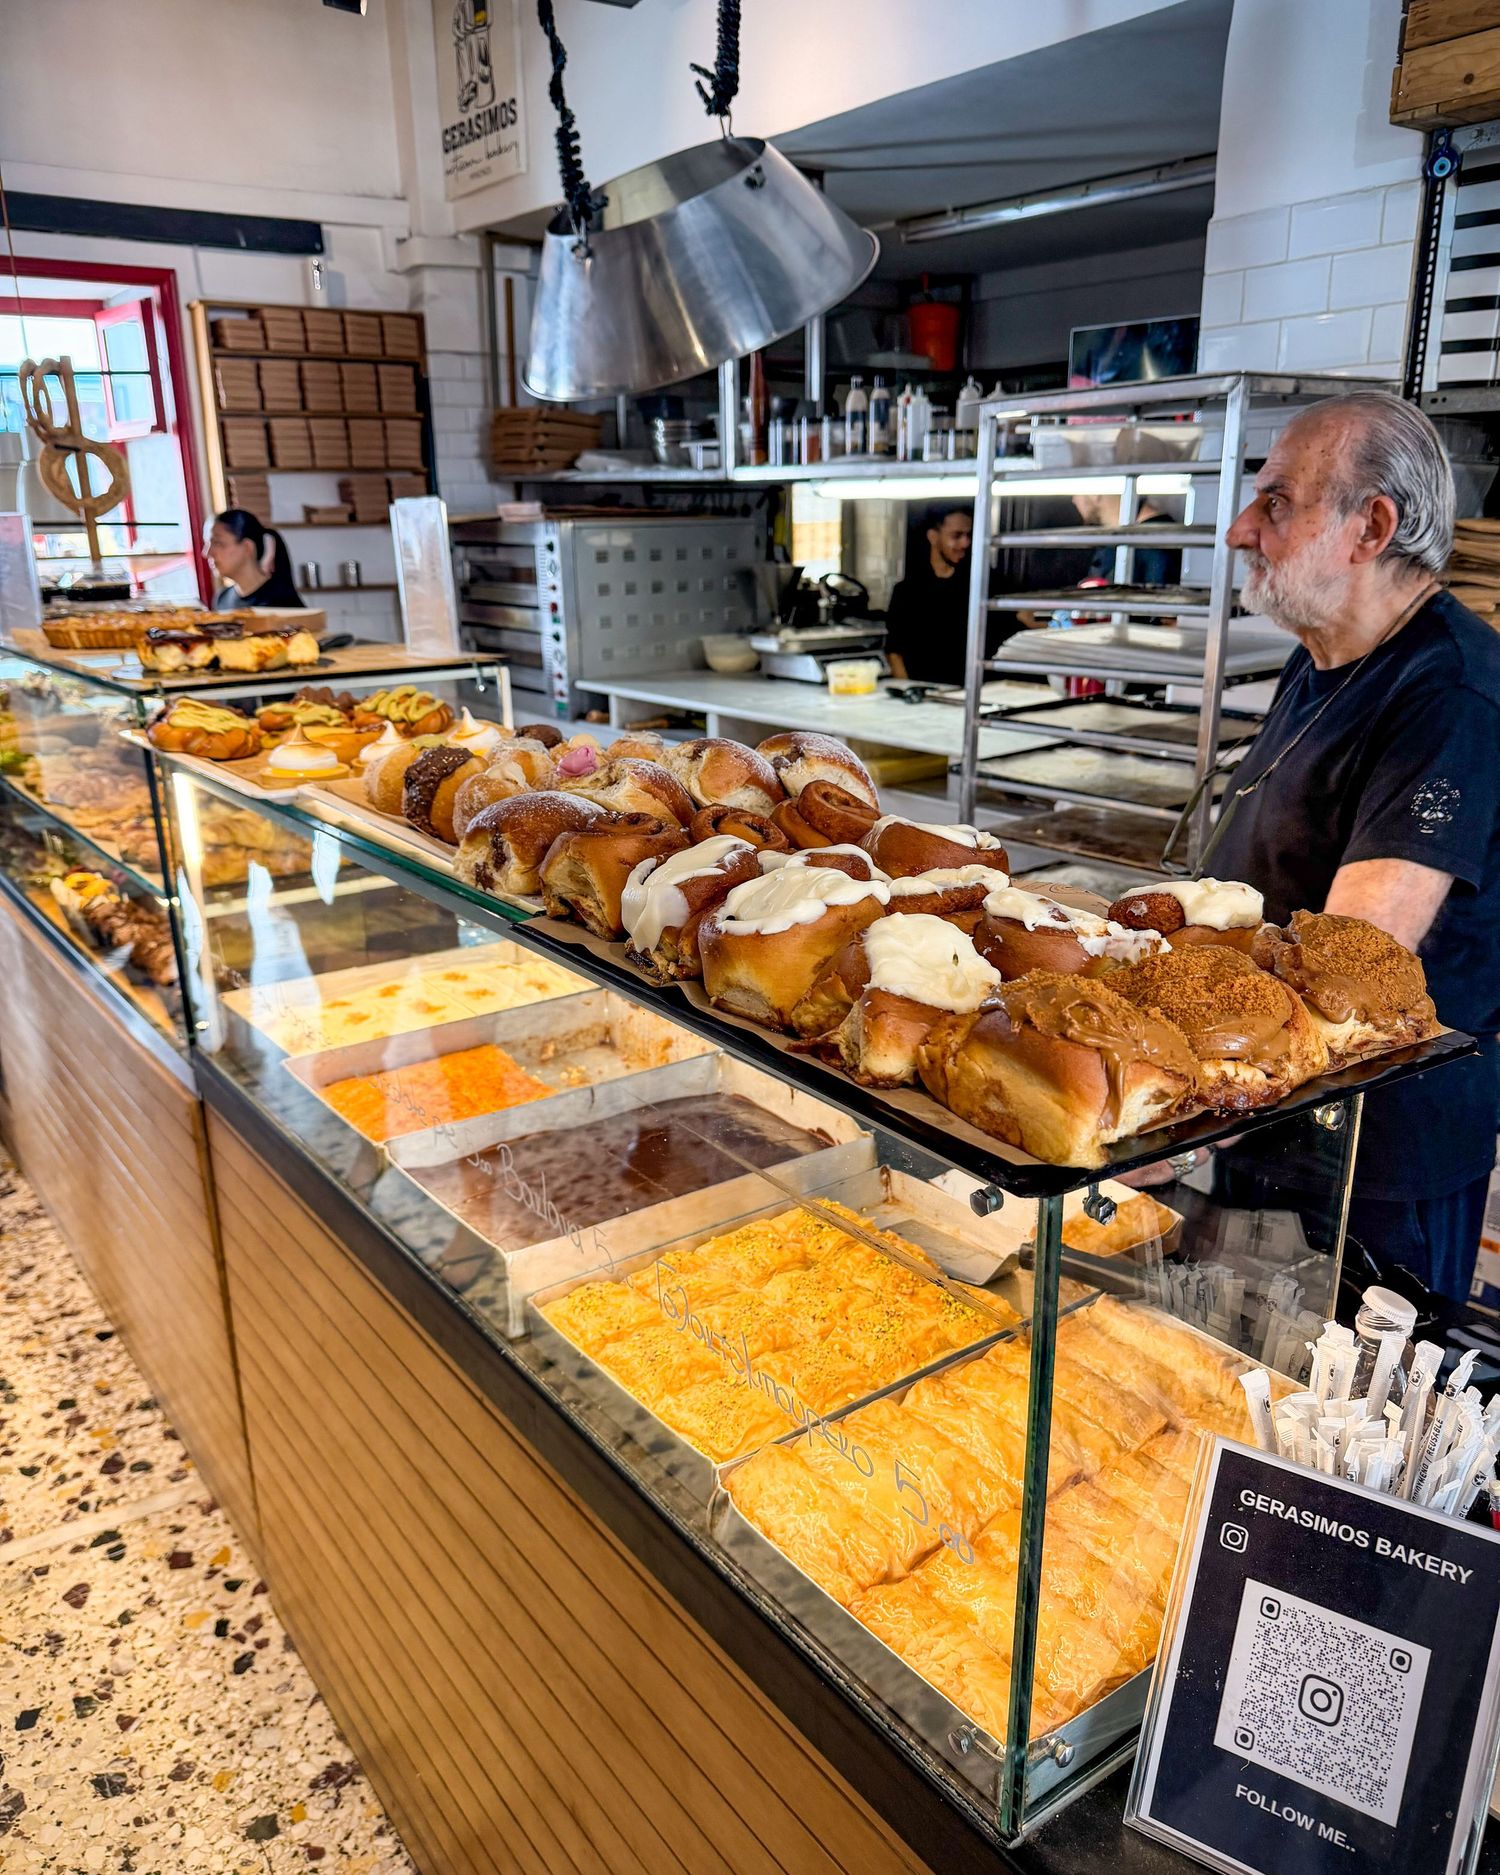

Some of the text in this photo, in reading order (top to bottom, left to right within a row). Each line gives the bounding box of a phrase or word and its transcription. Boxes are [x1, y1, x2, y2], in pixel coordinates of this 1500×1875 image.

[442, 98, 518, 154] GERASIMOS
[1426, 1417, 1444, 1457] REUSABLE
[1239, 1489, 1474, 1585] GERASIMOS BAKERY
[1235, 1784, 1356, 1853] FOLLOW ME..
